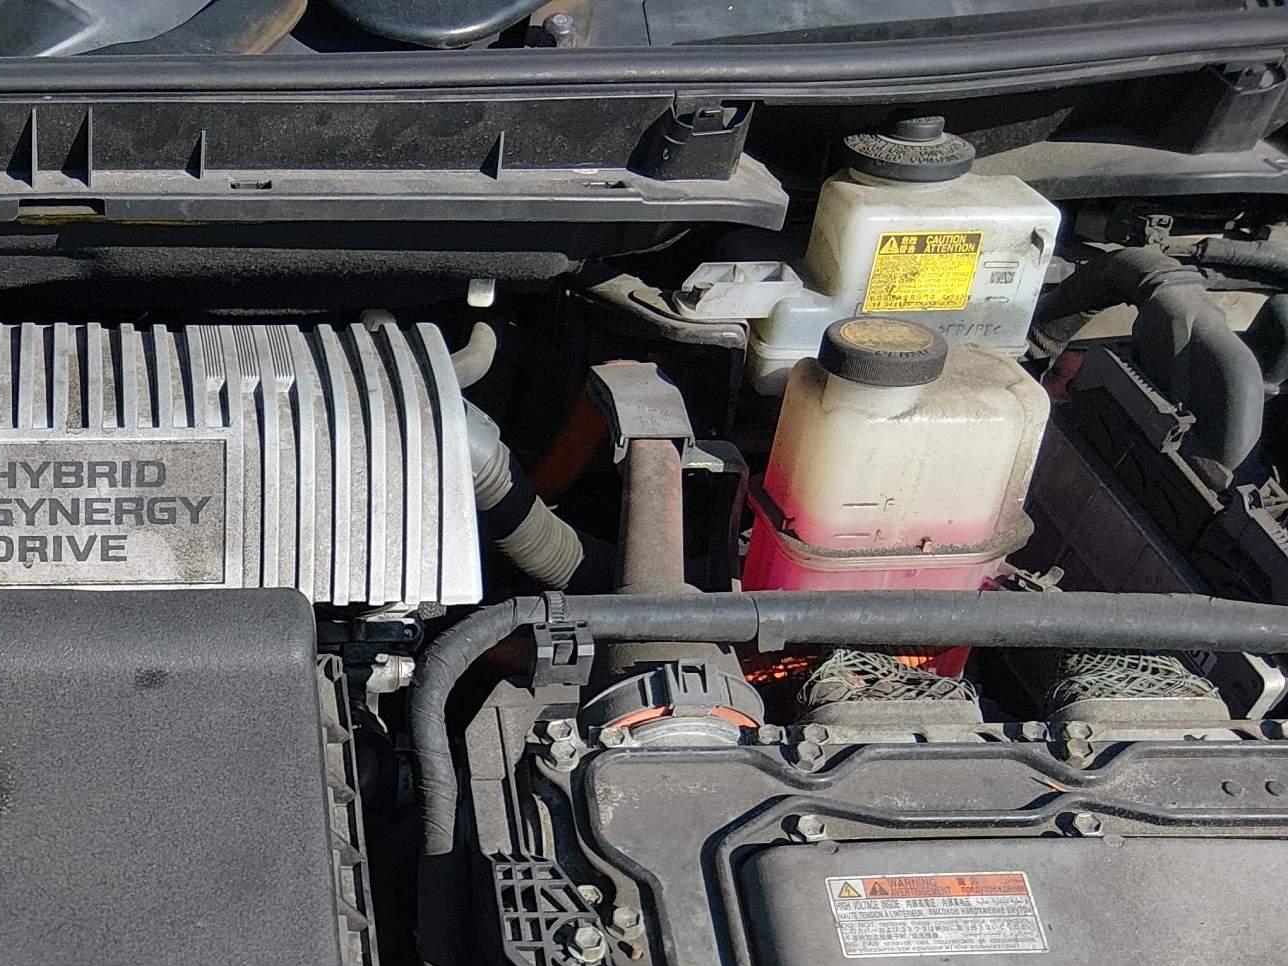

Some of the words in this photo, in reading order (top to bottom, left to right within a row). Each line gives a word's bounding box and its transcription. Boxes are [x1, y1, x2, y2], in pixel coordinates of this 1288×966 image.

[925, 235, 967, 244] CAUTION
[923, 244, 975, 253] ATTENTION
[889, 877, 937, 888] WARNING
